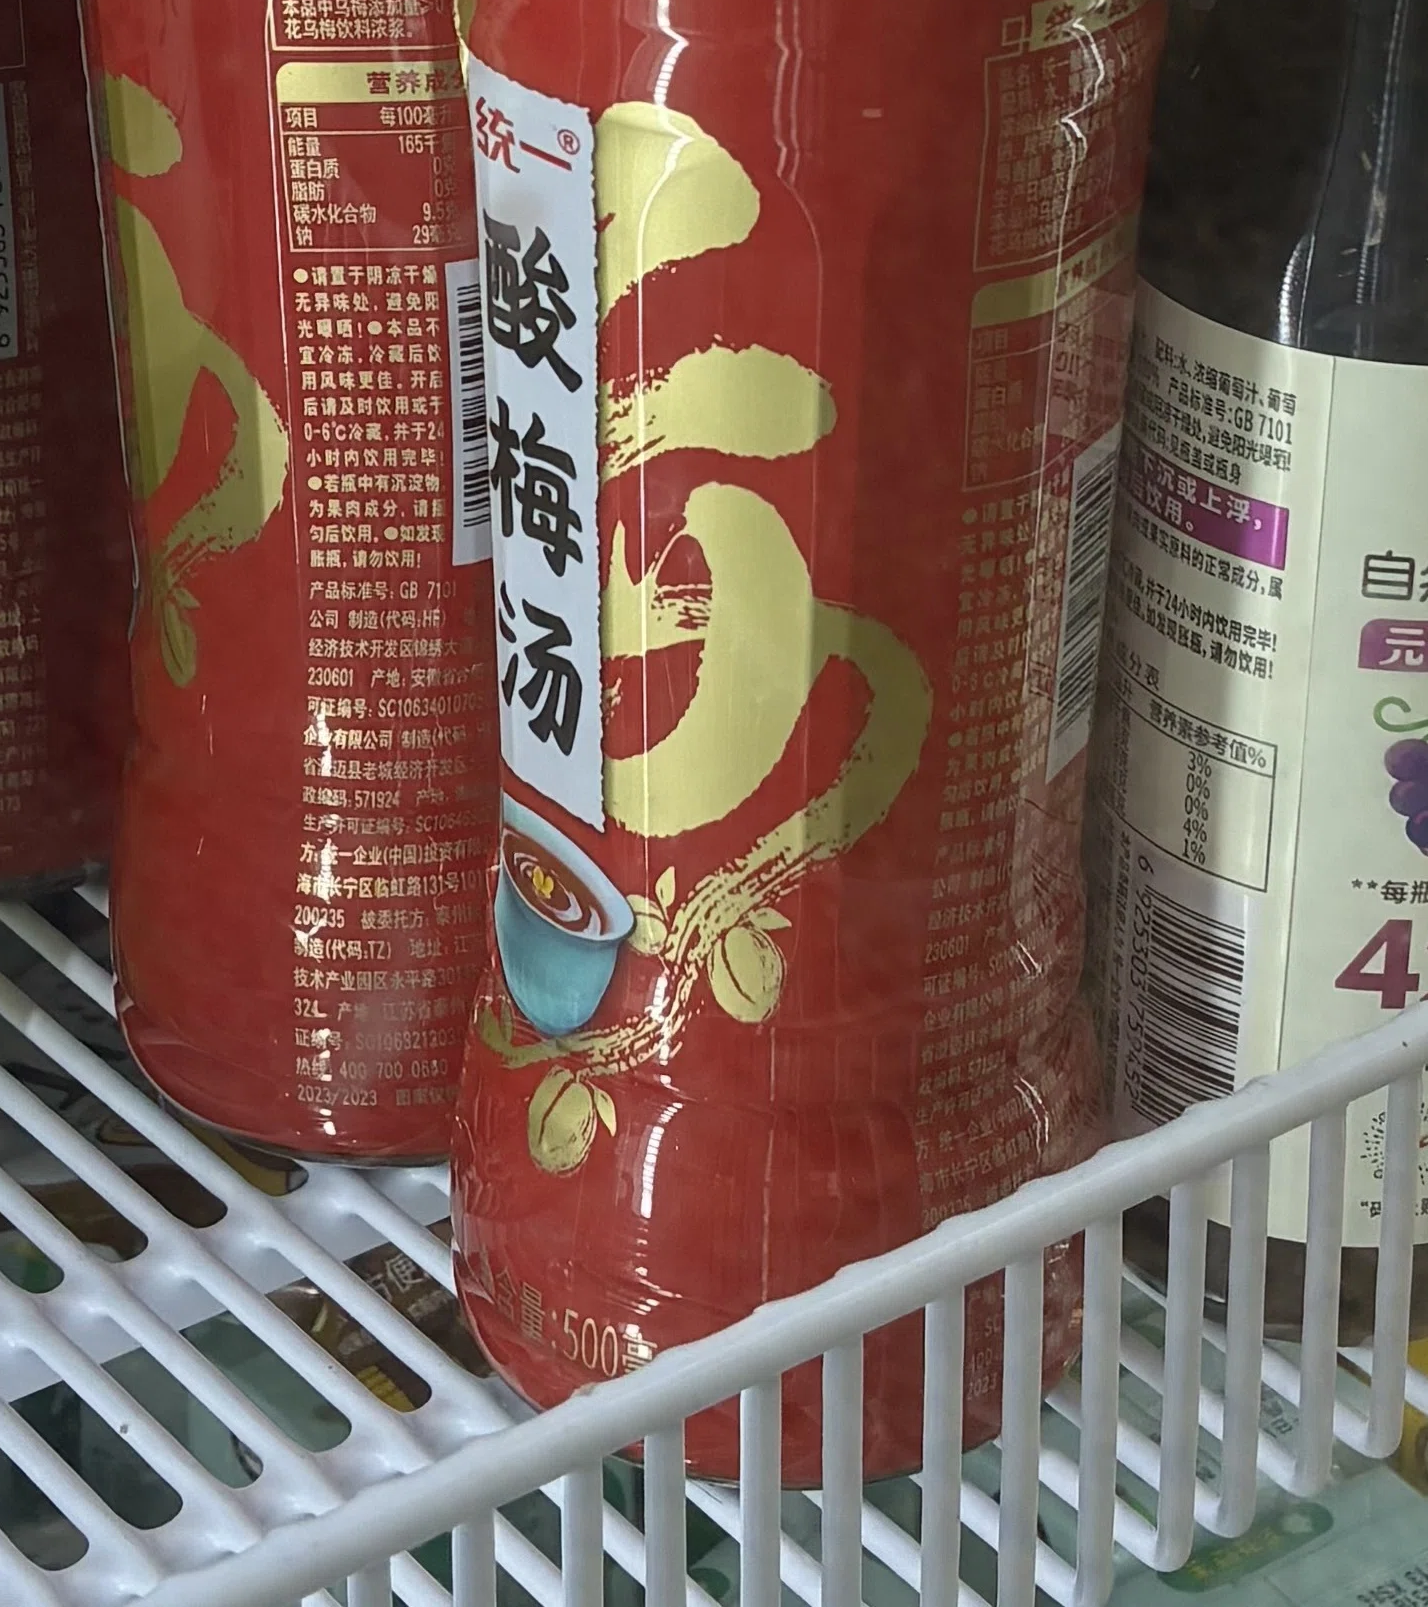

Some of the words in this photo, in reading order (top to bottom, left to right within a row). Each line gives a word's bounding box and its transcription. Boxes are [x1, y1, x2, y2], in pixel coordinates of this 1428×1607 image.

[285, 107, 318, 129] 项目
[287, 135, 322, 157] 能量
[289, 158, 340, 179] 蛋白质
[291, 181, 325, 202] 脂肪
[293, 203, 377, 224] 碳水化合物
[296, 227, 313, 246] 钠
[1258, 413, 1293, 445] 7101
[483, 207, 585, 757] 酸梅汤
[399, 581, 418, 600] GB
[308, 609, 339, 630] 公司
[307, 666, 354, 687] 230601
[1148, 698, 1267, 769] 营养素参考值%
[1187, 750, 1212, 778] 3%
[1186, 773, 1211, 800] 0%
[1184, 795, 1209, 822] 0%
[1183, 817, 1208, 843] 4%
[1182, 838, 1206, 866] 1%
[1137, 854, 1155, 876] 6
[1130, 888, 1152, 994] 925303
